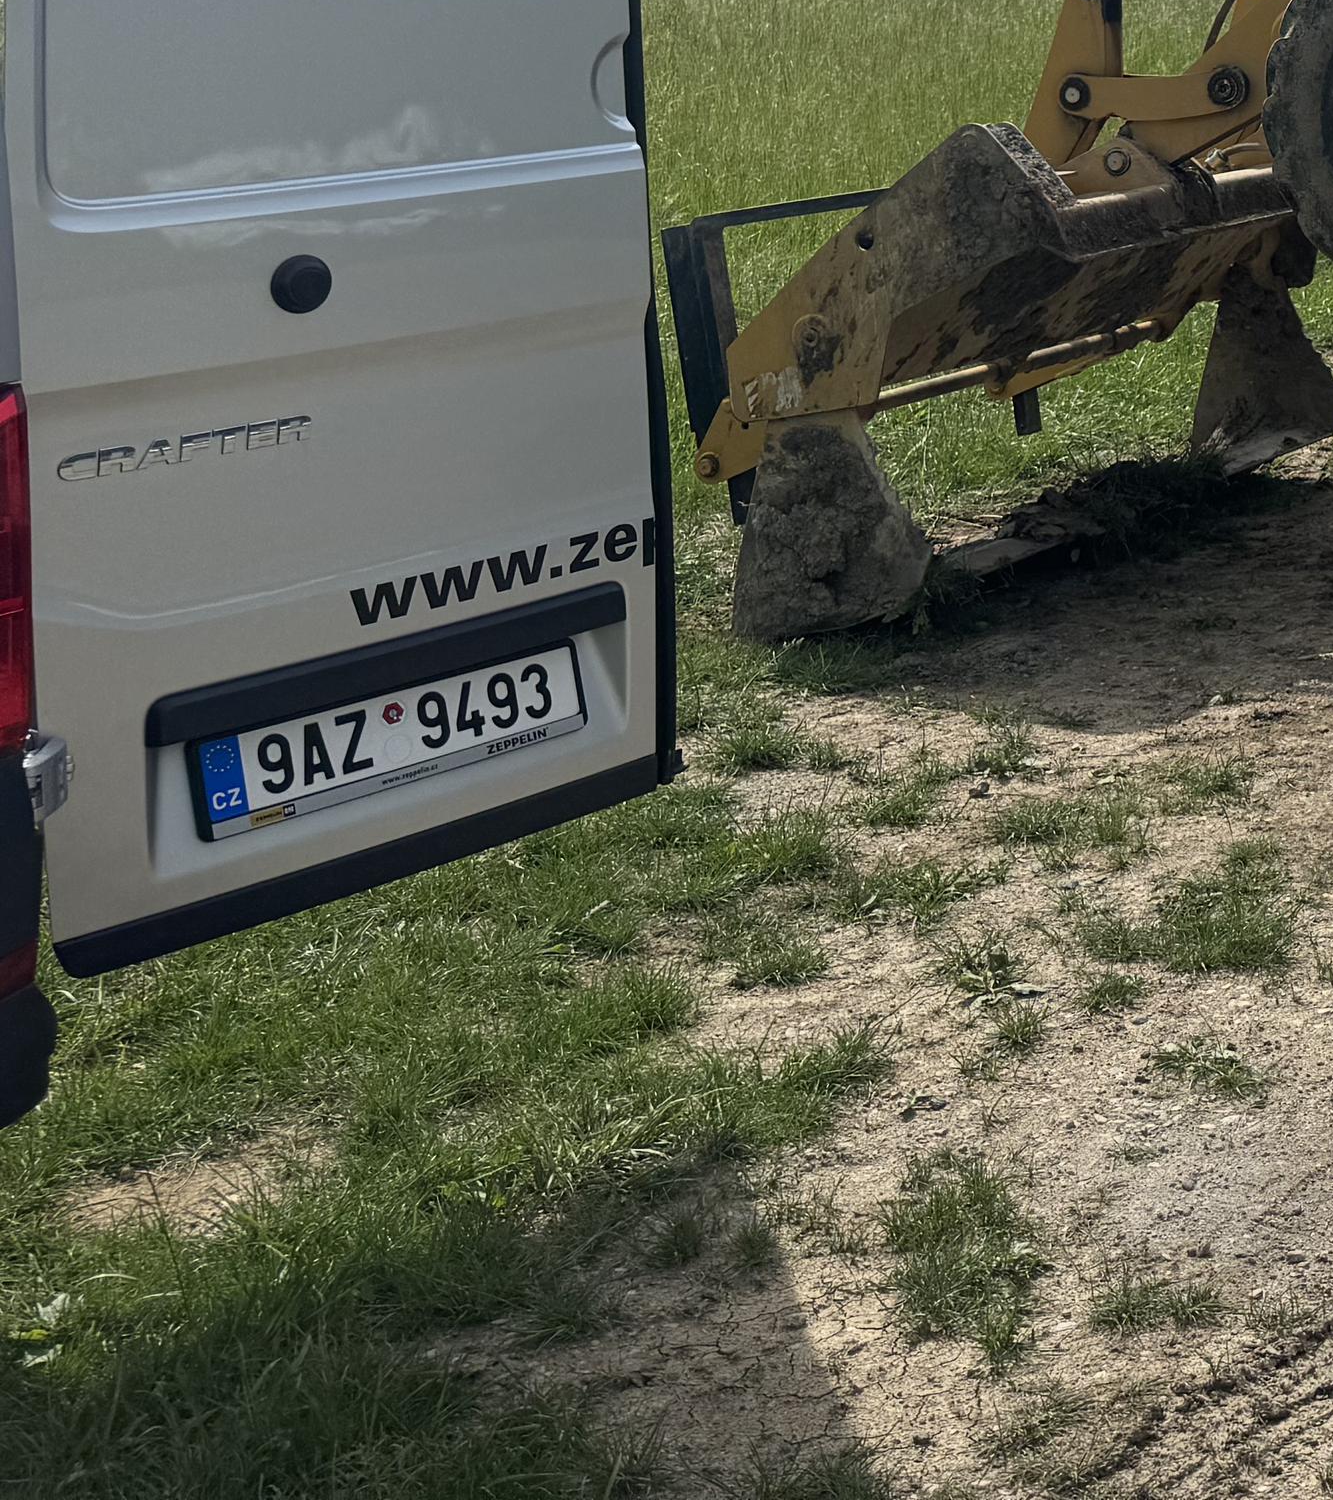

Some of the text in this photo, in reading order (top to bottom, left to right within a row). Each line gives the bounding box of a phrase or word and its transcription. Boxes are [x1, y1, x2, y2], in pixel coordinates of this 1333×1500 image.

[57, 414, 312, 482] CRAFTER
[257, 663, 553, 794] 9AZ 9493
[486, 729, 548, 755] ZEPPELIN
[212, 787, 243, 812] CZ
